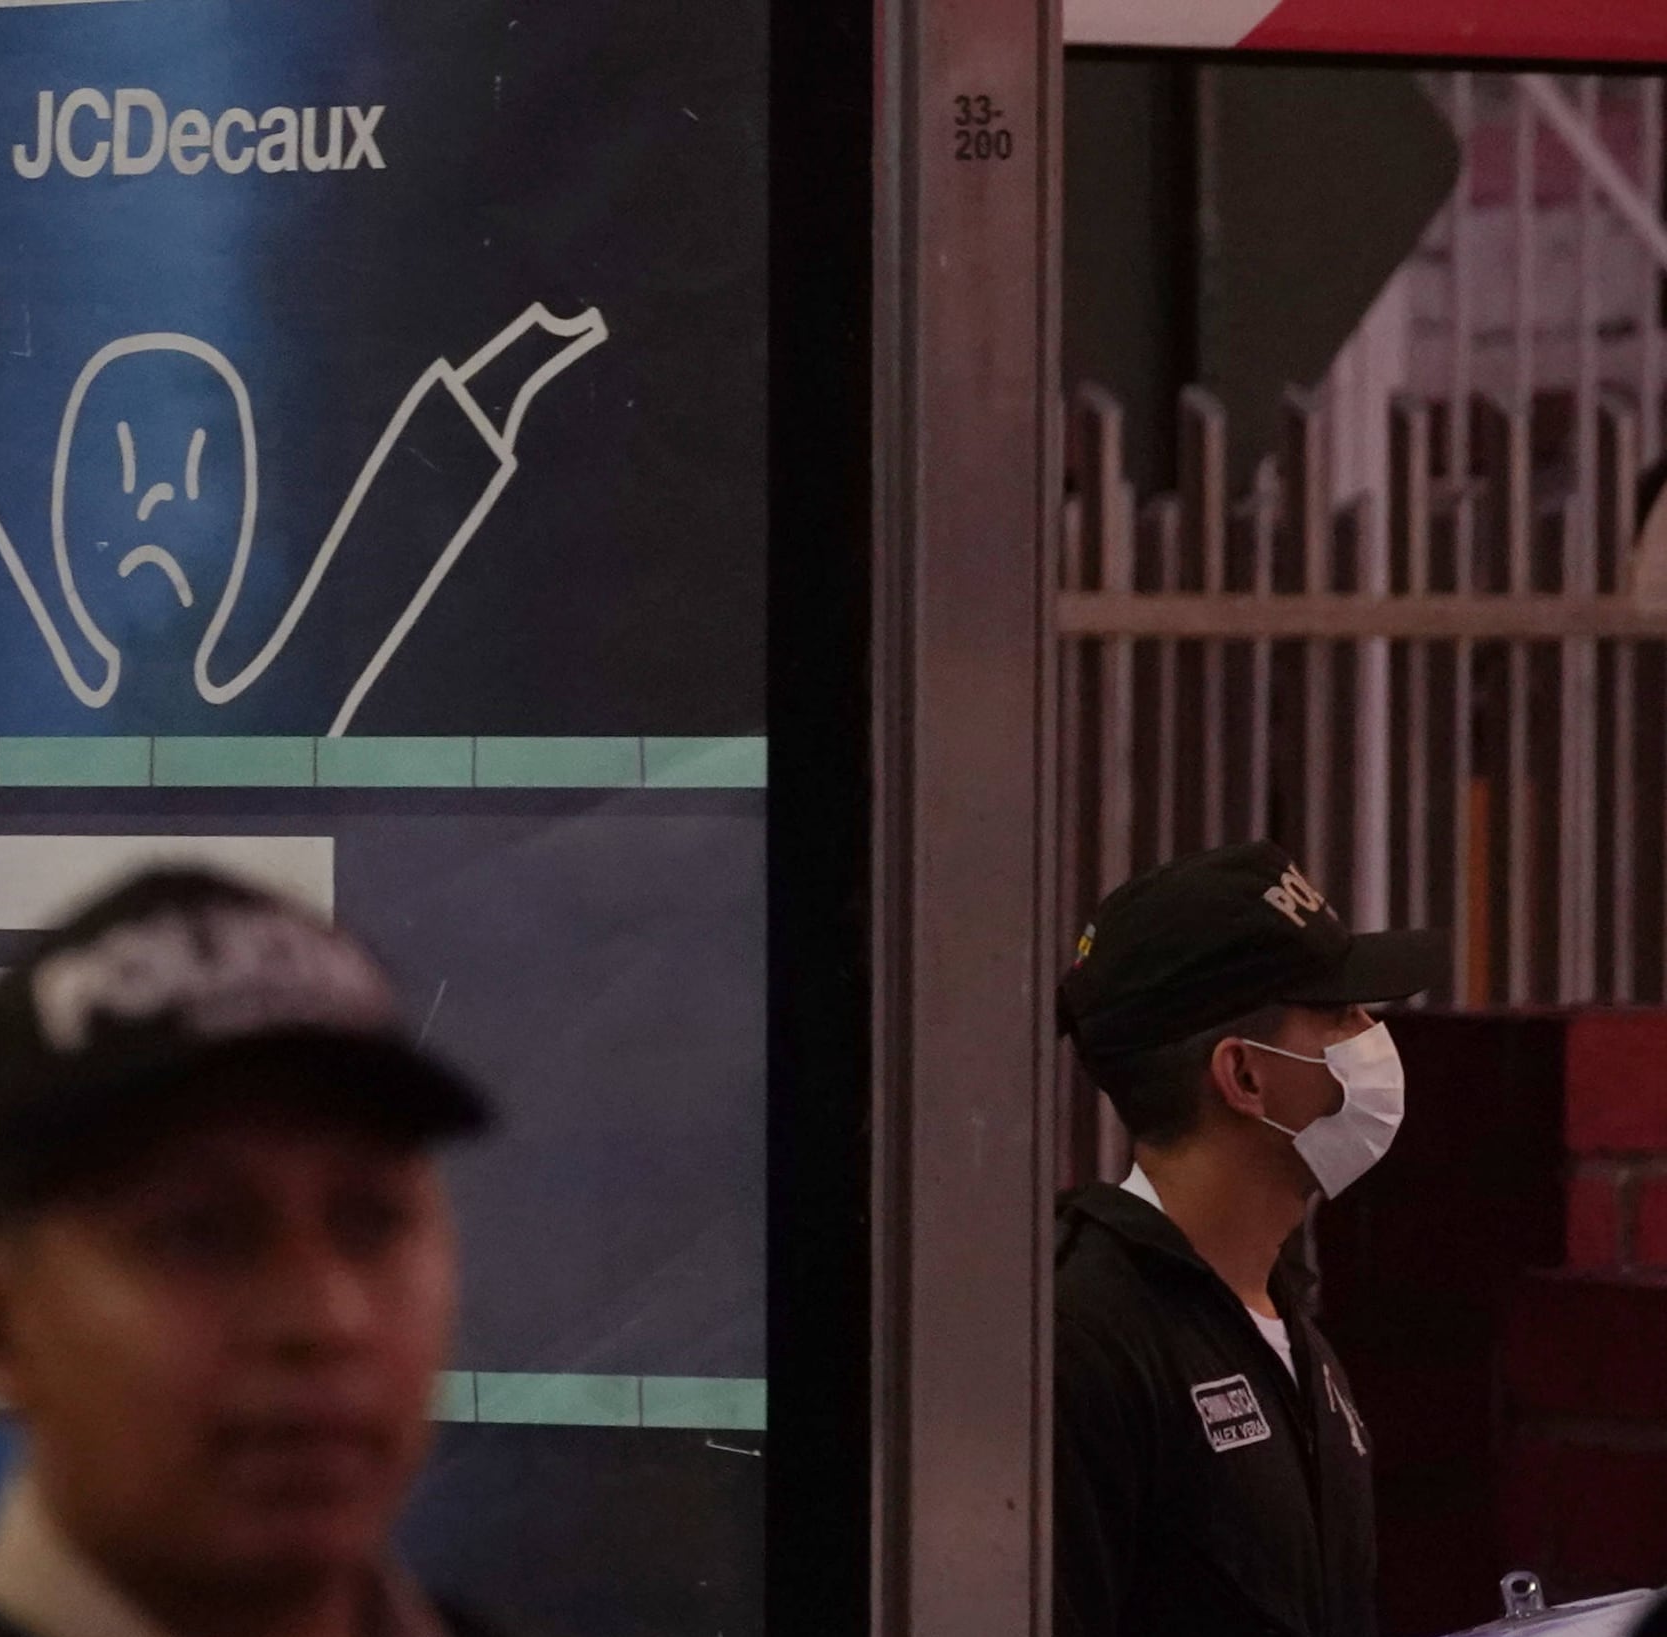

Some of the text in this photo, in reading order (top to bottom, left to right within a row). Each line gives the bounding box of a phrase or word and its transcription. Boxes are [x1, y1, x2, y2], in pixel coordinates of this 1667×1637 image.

[954, 94, 1004, 126] 33-
[12, 87, 387, 179] JCDecaux
[954, 129, 1013, 160] 200
